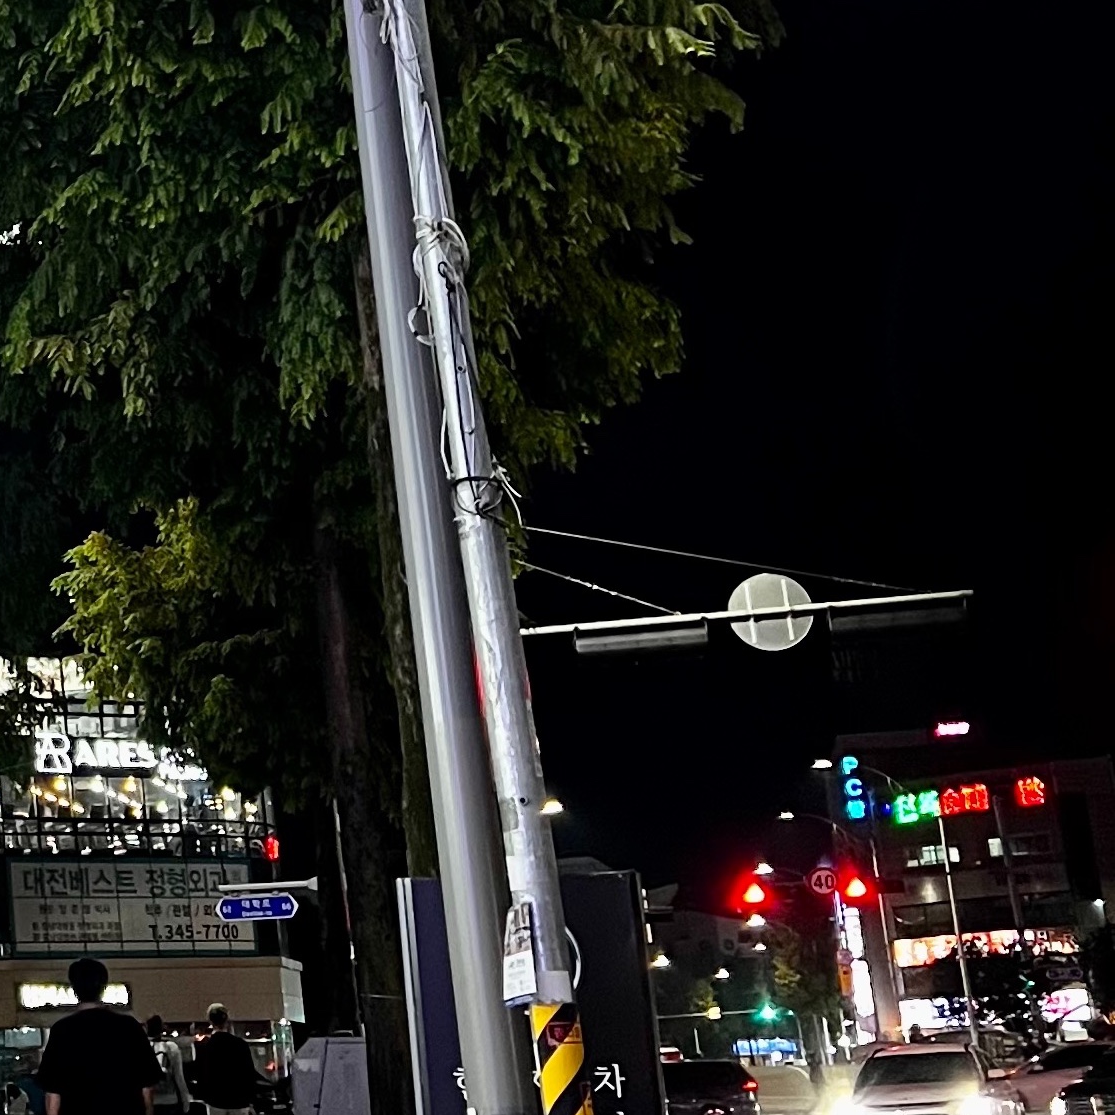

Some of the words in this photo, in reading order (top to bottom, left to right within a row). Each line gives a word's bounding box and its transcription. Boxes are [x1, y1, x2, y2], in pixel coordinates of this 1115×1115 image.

[74, 738, 158, 769] ARES
[22, 867, 138, 896] 대전베스트
[145, 868, 230, 898] 정형외과
[813, 873, 834, 889] 40
[148, 924, 239, 940] T.345-7700
